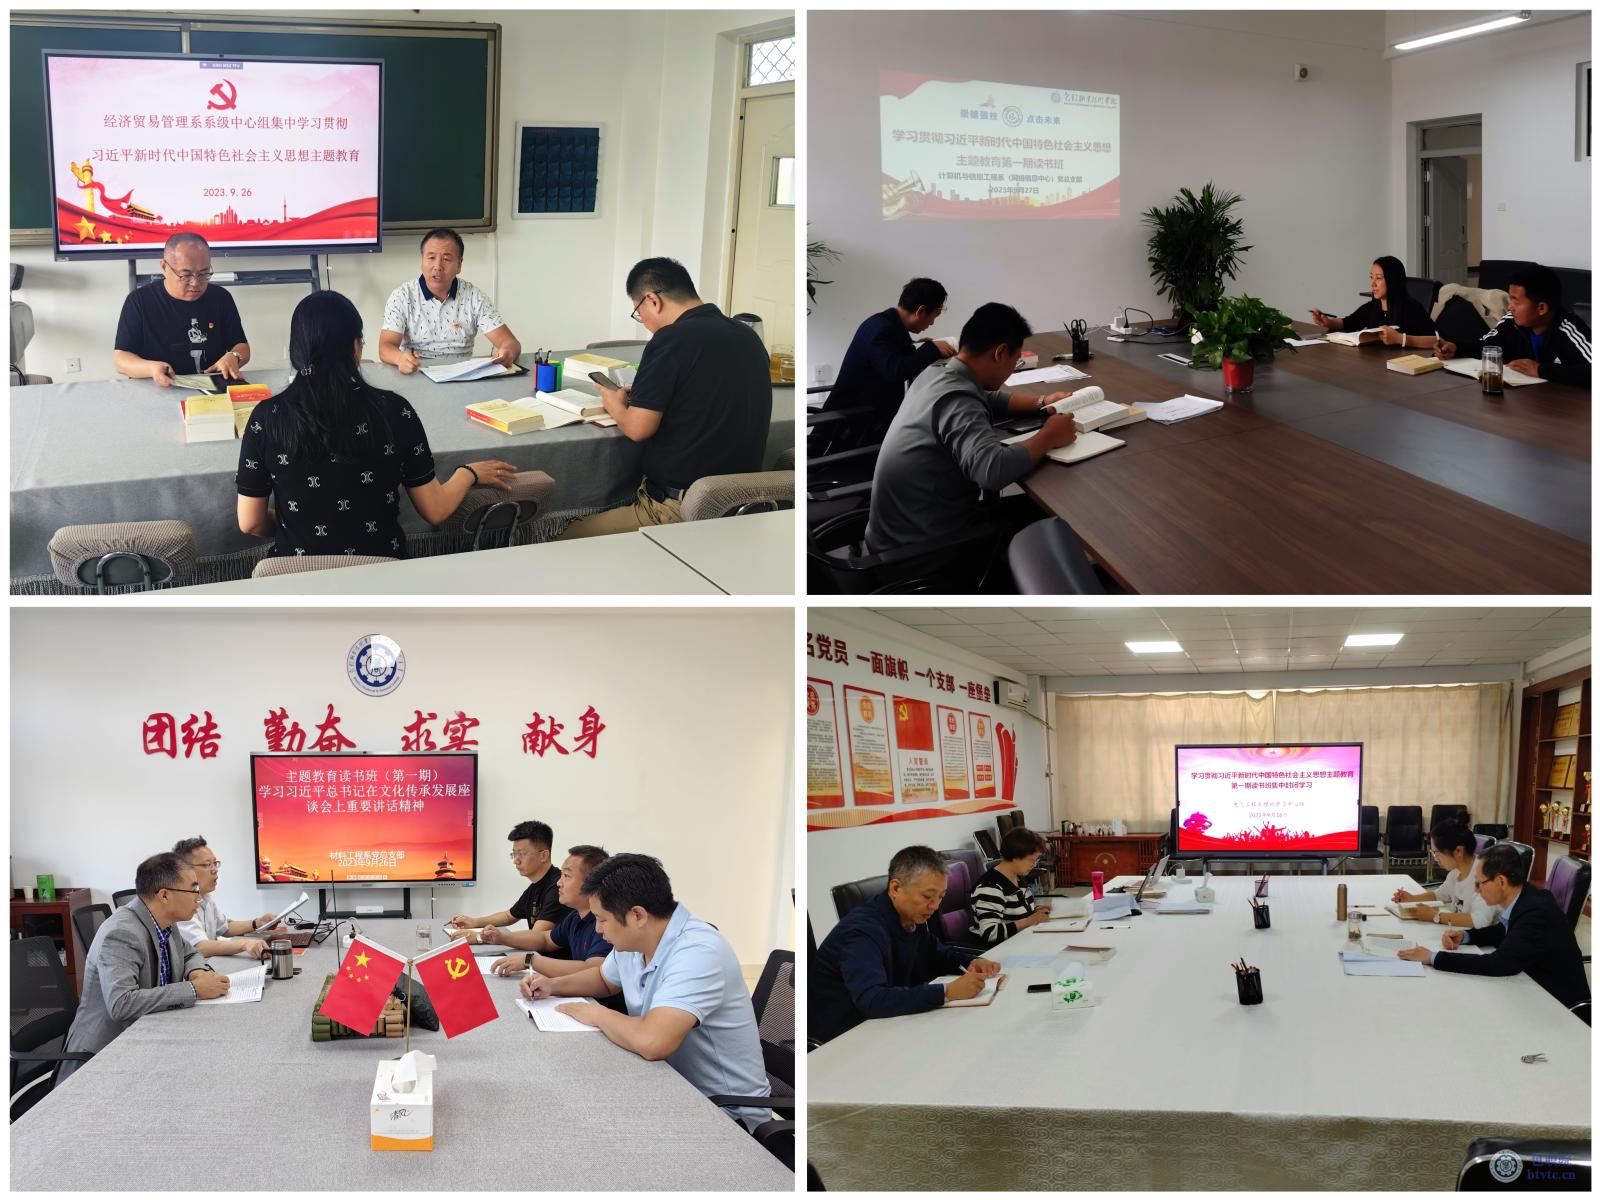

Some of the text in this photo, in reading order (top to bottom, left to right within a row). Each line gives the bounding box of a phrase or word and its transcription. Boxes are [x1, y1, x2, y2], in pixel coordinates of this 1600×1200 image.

[103, 114, 349, 131] 经济贸易管理系系级中心组集中学习贯彻
[892, 128, 1112, 153] 学习贯彻习近平新时代中国特色社会主义思想
[92, 148, 360, 163] 习近平新时代中国特色社会主义思想主题教育
[956, 154, 1064, 170] 主题教育第一期读书班
[856, 650, 910, 681] 一面旗帜
[914, 667, 956, 694] 一个支部
[959, 681, 992, 703] 一座堡垒
[142, 703, 607, 759] 团结 勤奋 求实 献身
[285, 768, 441, 783] 主题教育读书班（第一期）
[1191, 770, 1355, 780] 学习贯彻习近平新时代中国特色社会主义思想主题教育
[259, 783, 472, 799] 学习习近平总书记在文化传承发展座
[306, 799, 426, 814] 谈会上重要讲话精神
[330, 851, 405, 860] 材料工程系党总支部
[338, 858, 398, 868] 2023年9月26日
